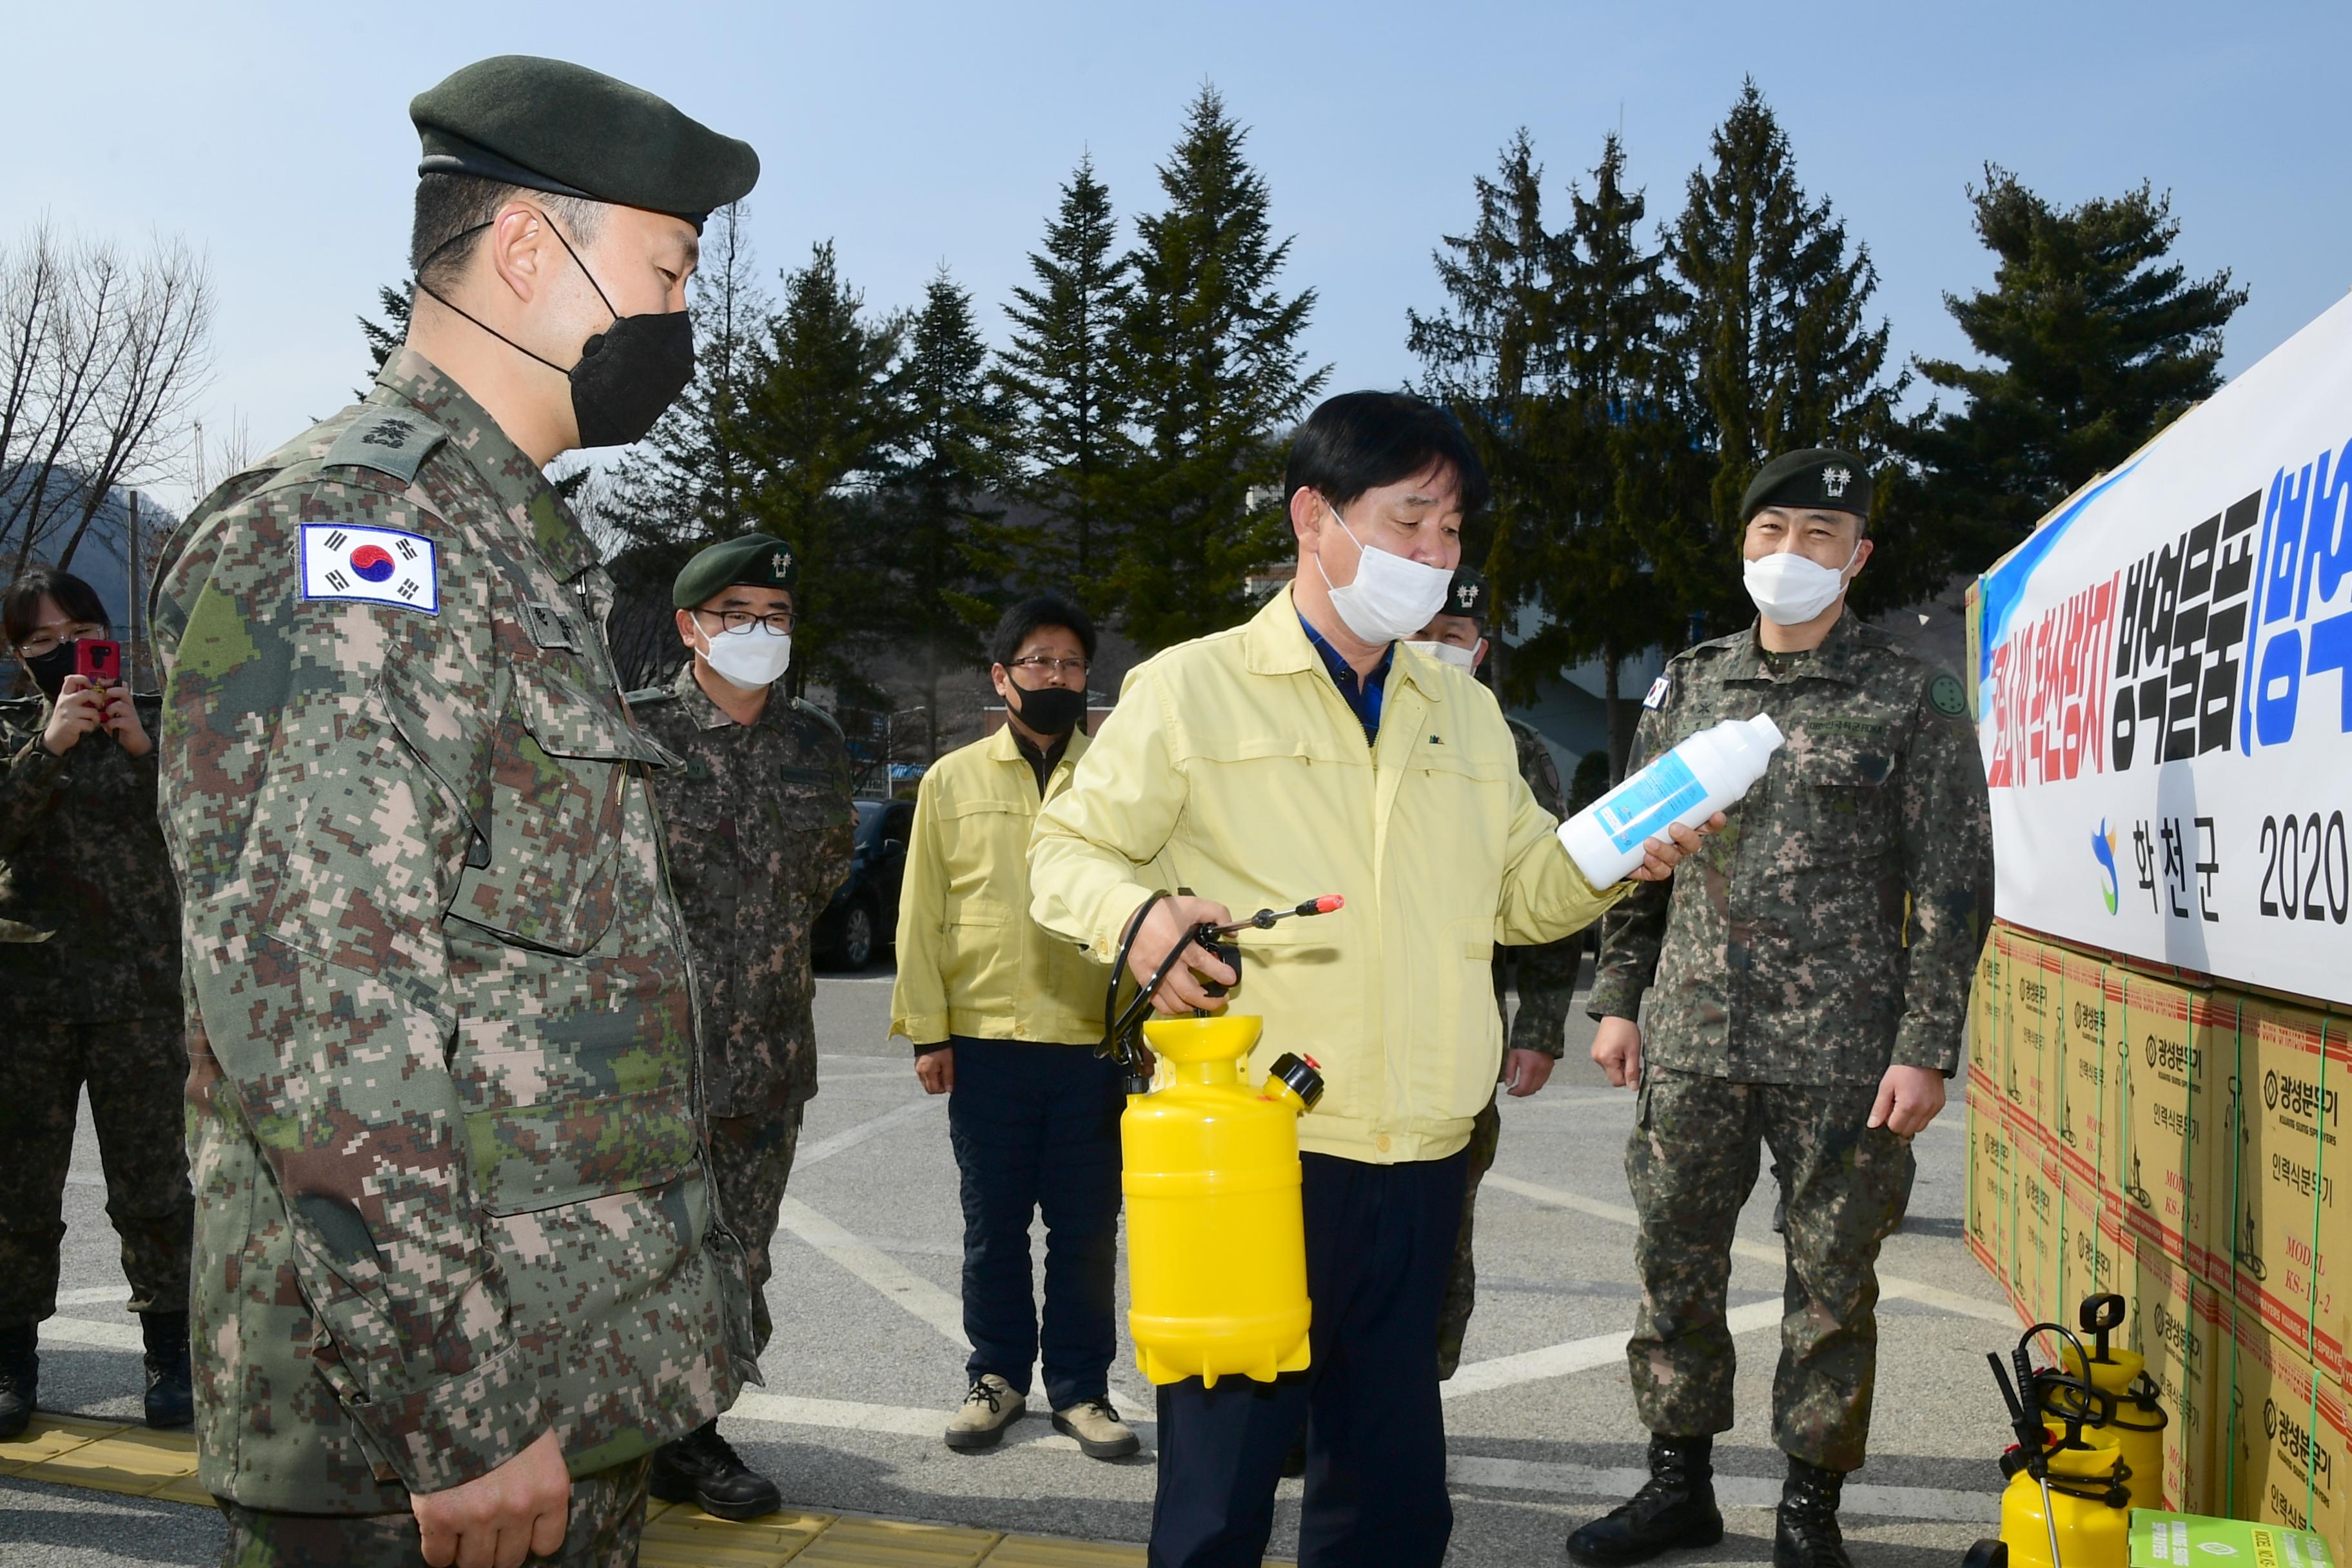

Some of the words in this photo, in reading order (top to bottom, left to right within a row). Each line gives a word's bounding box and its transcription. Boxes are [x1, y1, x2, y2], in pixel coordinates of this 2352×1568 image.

[2030, 569, 2121, 786] 확산방지
[2112, 488, 2262, 772] 방역물품
[2133, 816, 2219, 923] 화천군
